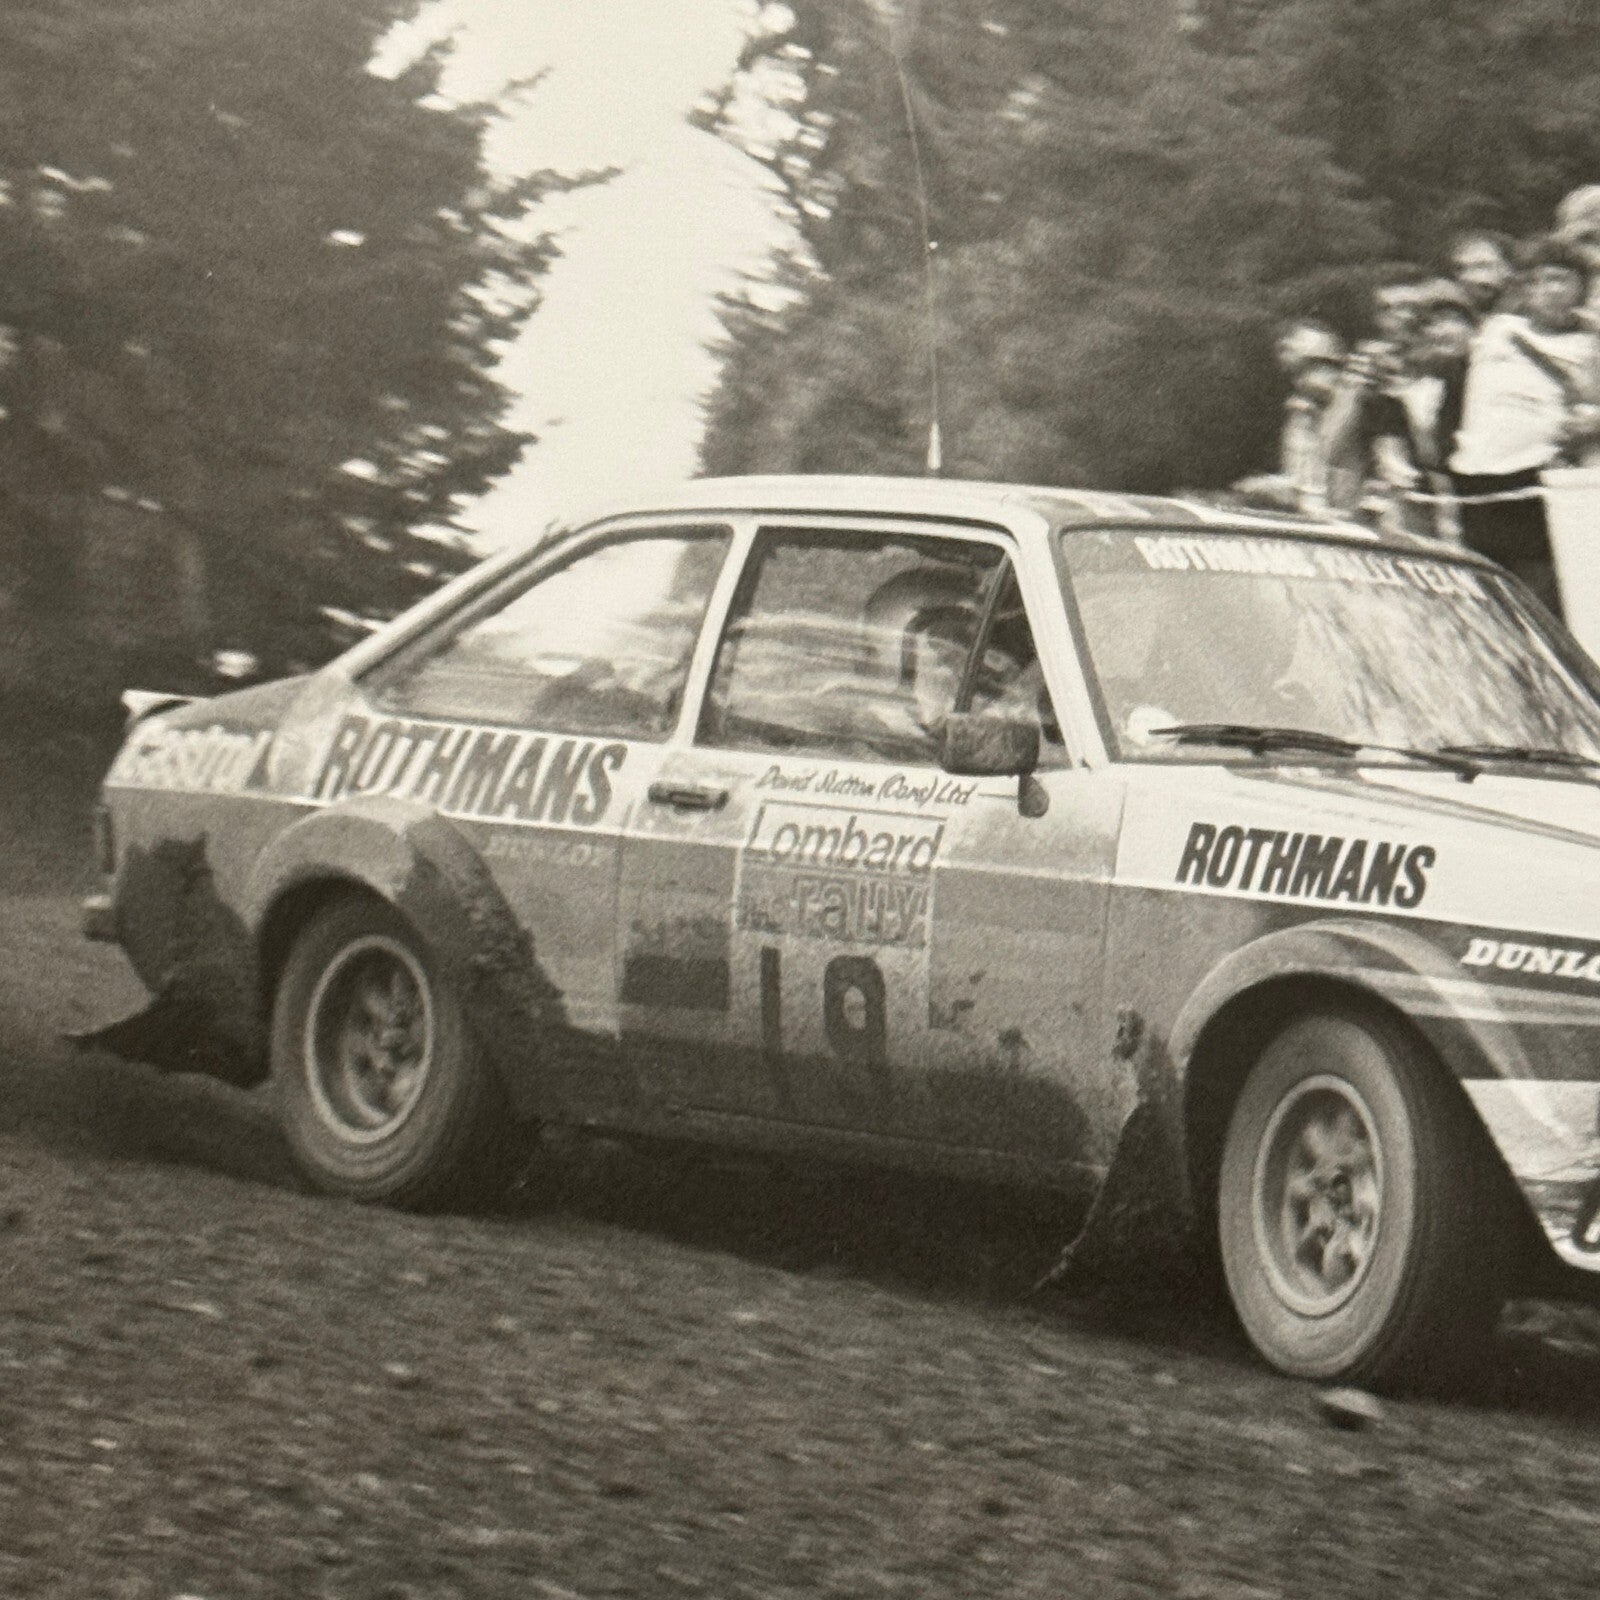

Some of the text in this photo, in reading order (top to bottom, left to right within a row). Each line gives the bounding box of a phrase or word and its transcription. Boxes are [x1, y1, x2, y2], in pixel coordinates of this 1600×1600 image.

[312, 714, 628, 826] ROTHMANS
[744, 805, 945, 874] Lombard
[1175, 822, 1436, 909] ROTHMANS
[796, 876, 928, 944] rally
[759, 945, 888, 1076] 19
